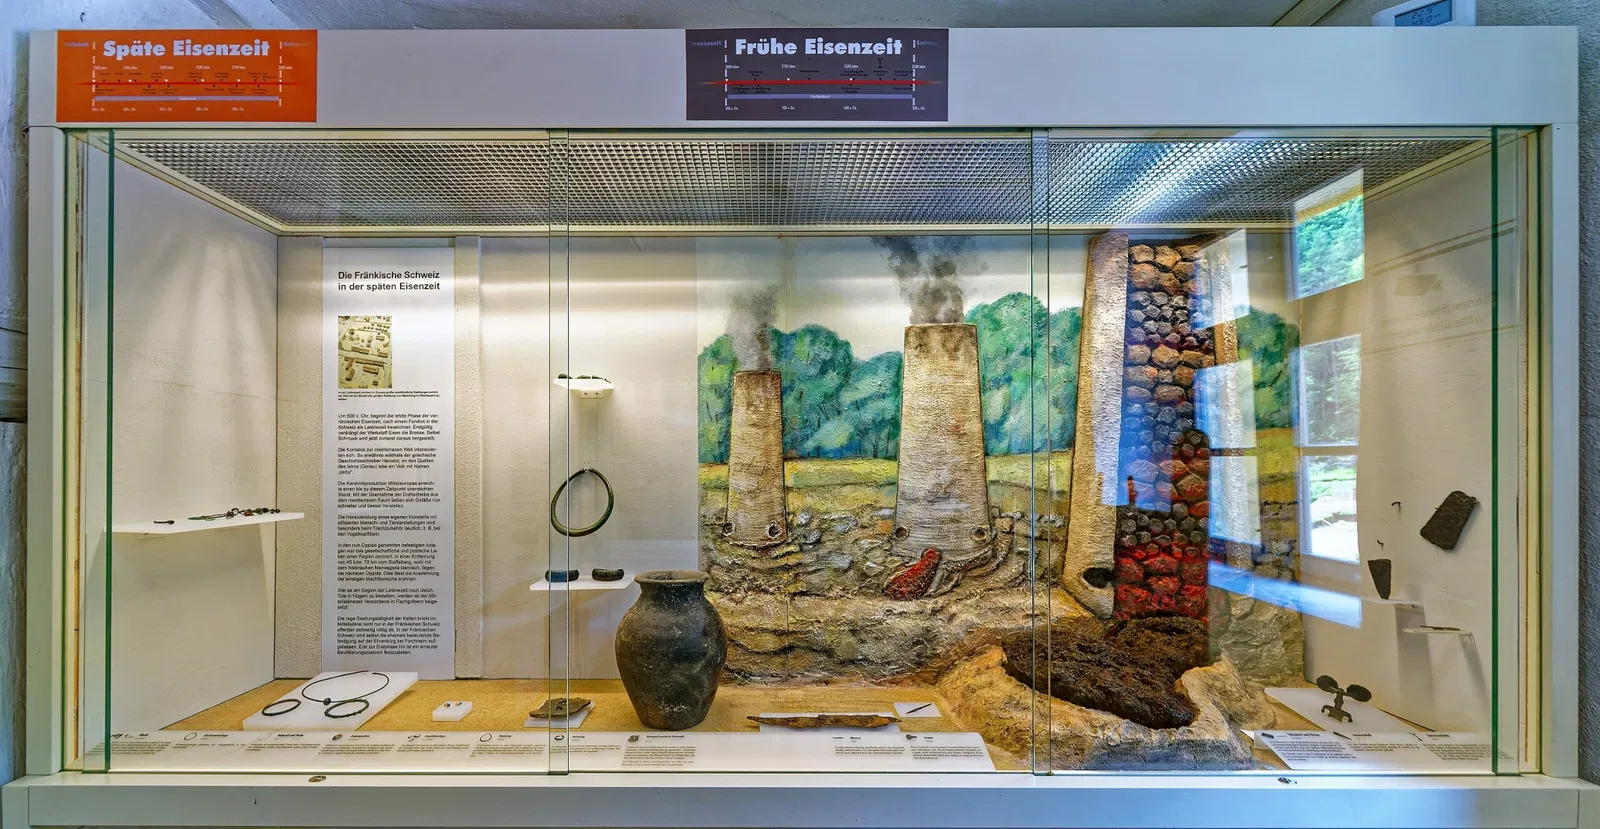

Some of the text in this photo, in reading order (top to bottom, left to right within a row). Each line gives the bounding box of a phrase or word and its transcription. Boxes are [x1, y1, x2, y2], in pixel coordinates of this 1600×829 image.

[103, 39, 270, 60] Späte Eisenzeit
[735, 37, 902, 55] Frühe Eisenzeit
[338, 270, 440, 279] Die Fränkische Schweiz
[338, 282, 440, 292] in der späten Eisenzeit
